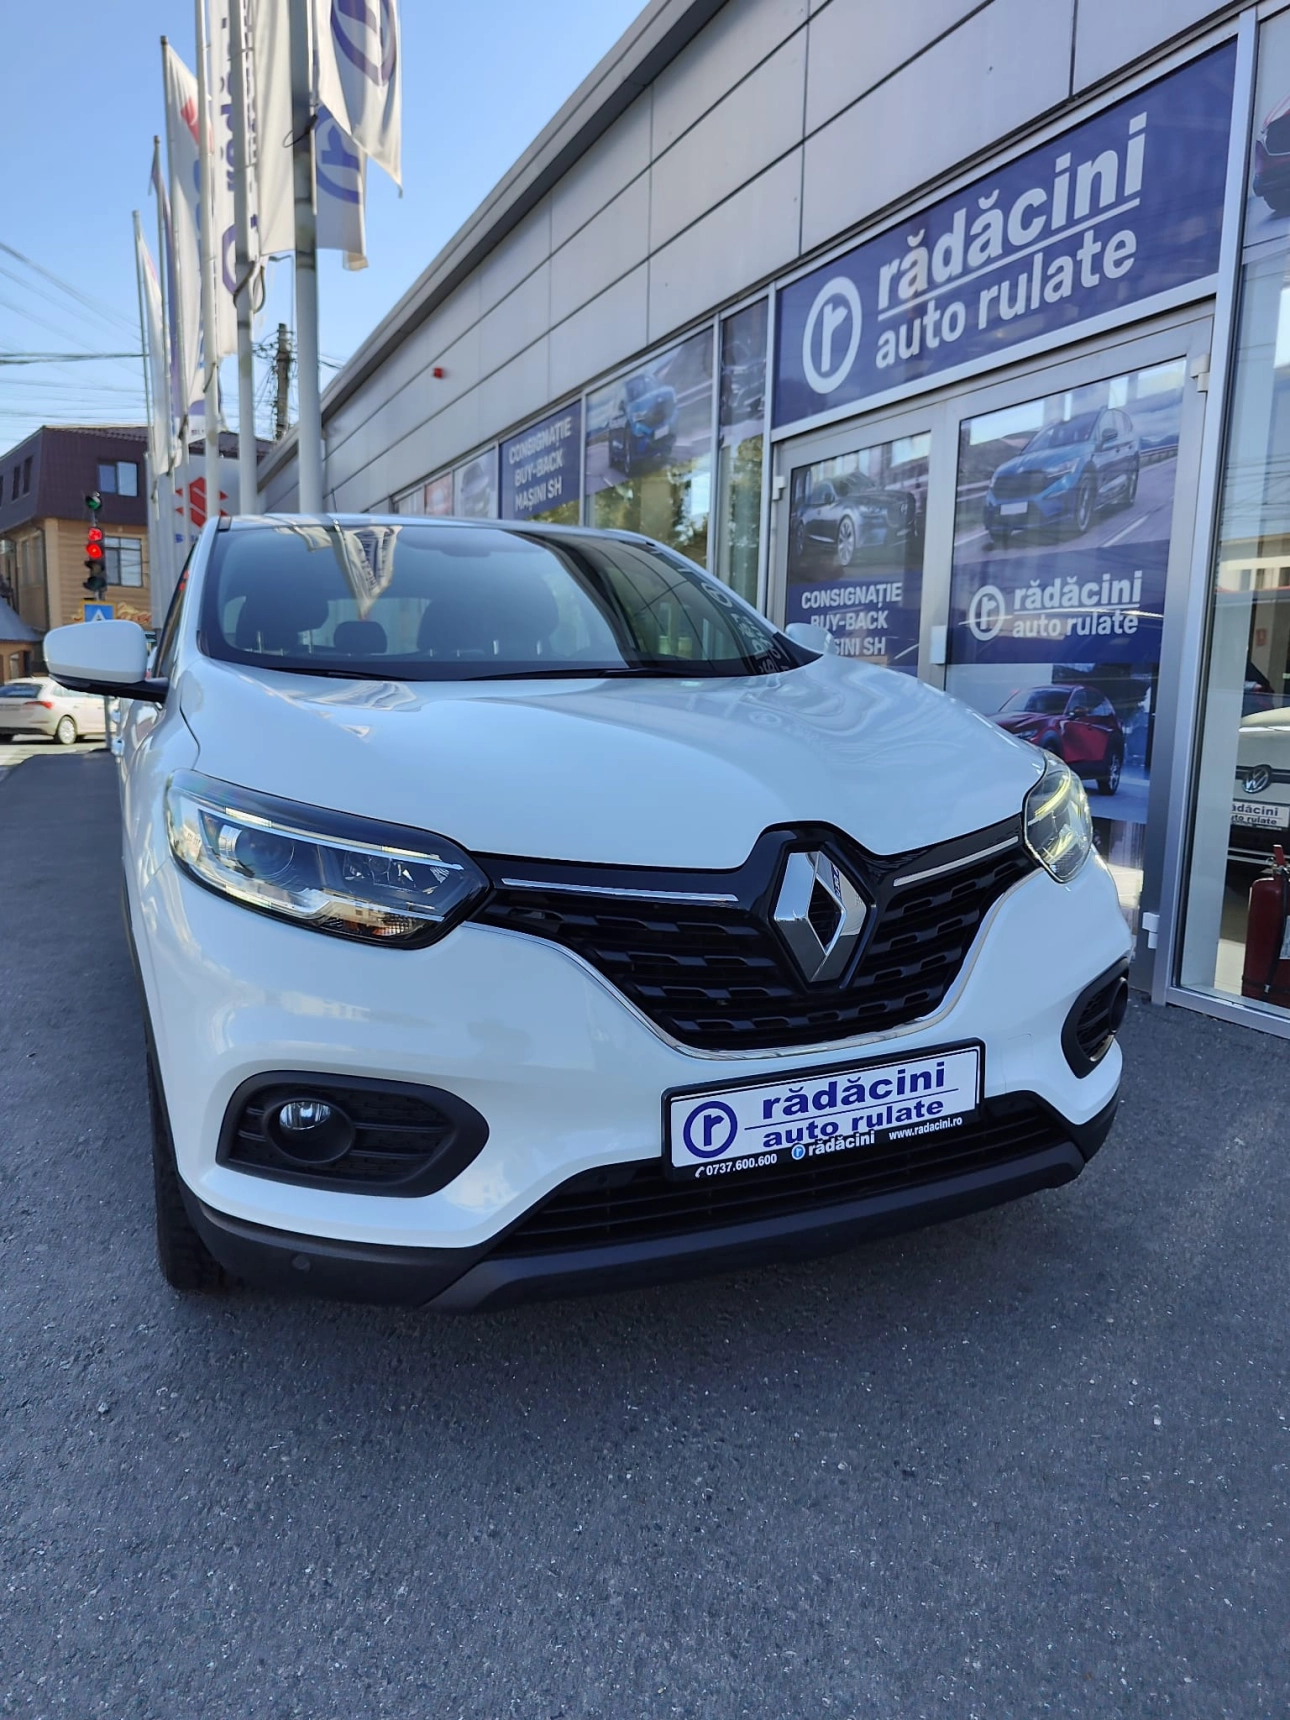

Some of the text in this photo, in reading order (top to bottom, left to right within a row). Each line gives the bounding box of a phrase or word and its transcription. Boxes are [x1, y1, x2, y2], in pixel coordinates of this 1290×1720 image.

[878, 112, 1147, 310] rădăcini
[875, 229, 1137, 369] auto rulate
[514, 448, 564, 487] BUY-BACK
[547, 476, 562, 499] SH
[801, 582, 903, 609] CONSIGNAȚIE
[1013, 570, 1143, 610] rădăcini
[810, 610, 889, 632] BUY-BACK
[1012, 609, 1139, 638] auto rulate
[863, 636, 886, 656] SH
[762, 1061, 945, 1120] rădăcini
[762, 1100, 944, 1149] auto rulate
[888, 1116, 963, 1141] www.radacini.ro
[808, 1130, 875, 1157] rădăcini
[706, 1153, 778, 1177] 0737.600.600
